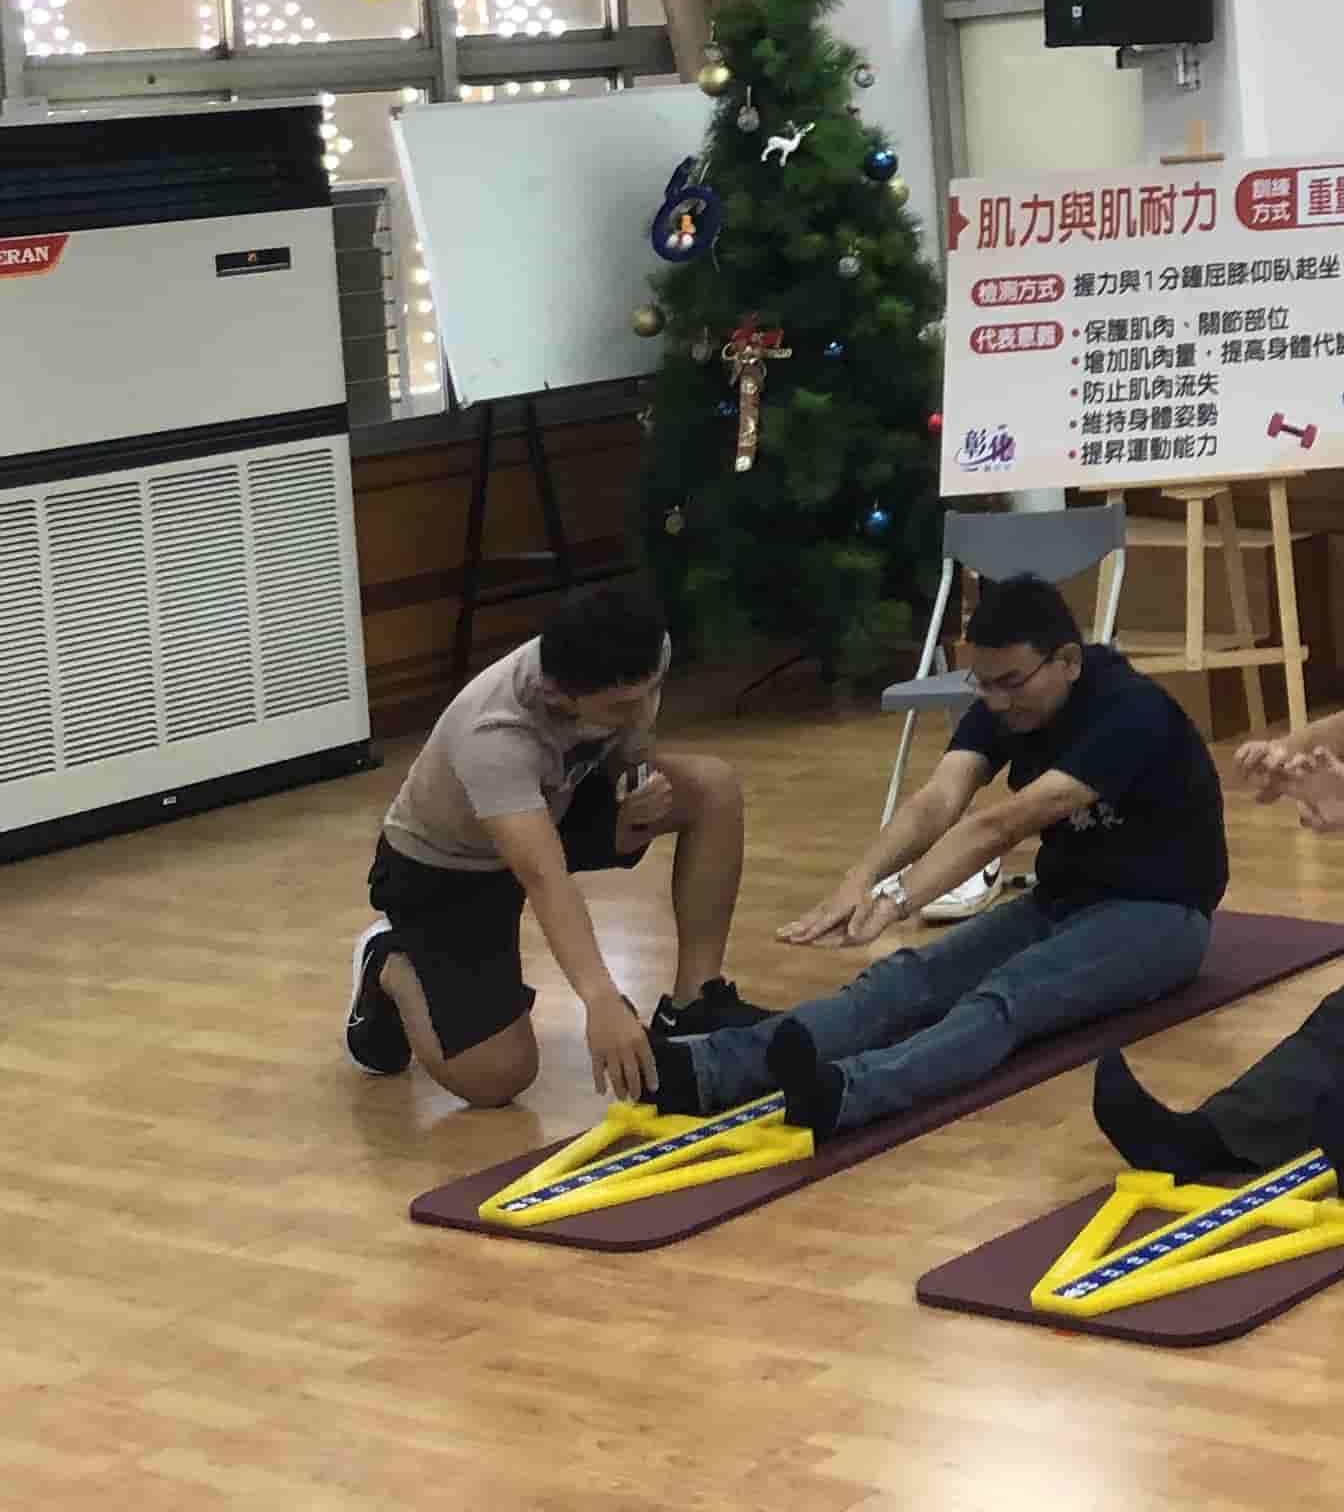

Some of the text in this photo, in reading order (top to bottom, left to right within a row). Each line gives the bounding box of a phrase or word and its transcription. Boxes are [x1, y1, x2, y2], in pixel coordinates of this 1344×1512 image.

[977, 182, 1218, 250] 肌力與肌耐力
[1082, 372, 1220, 405] 防止肌肉流失
